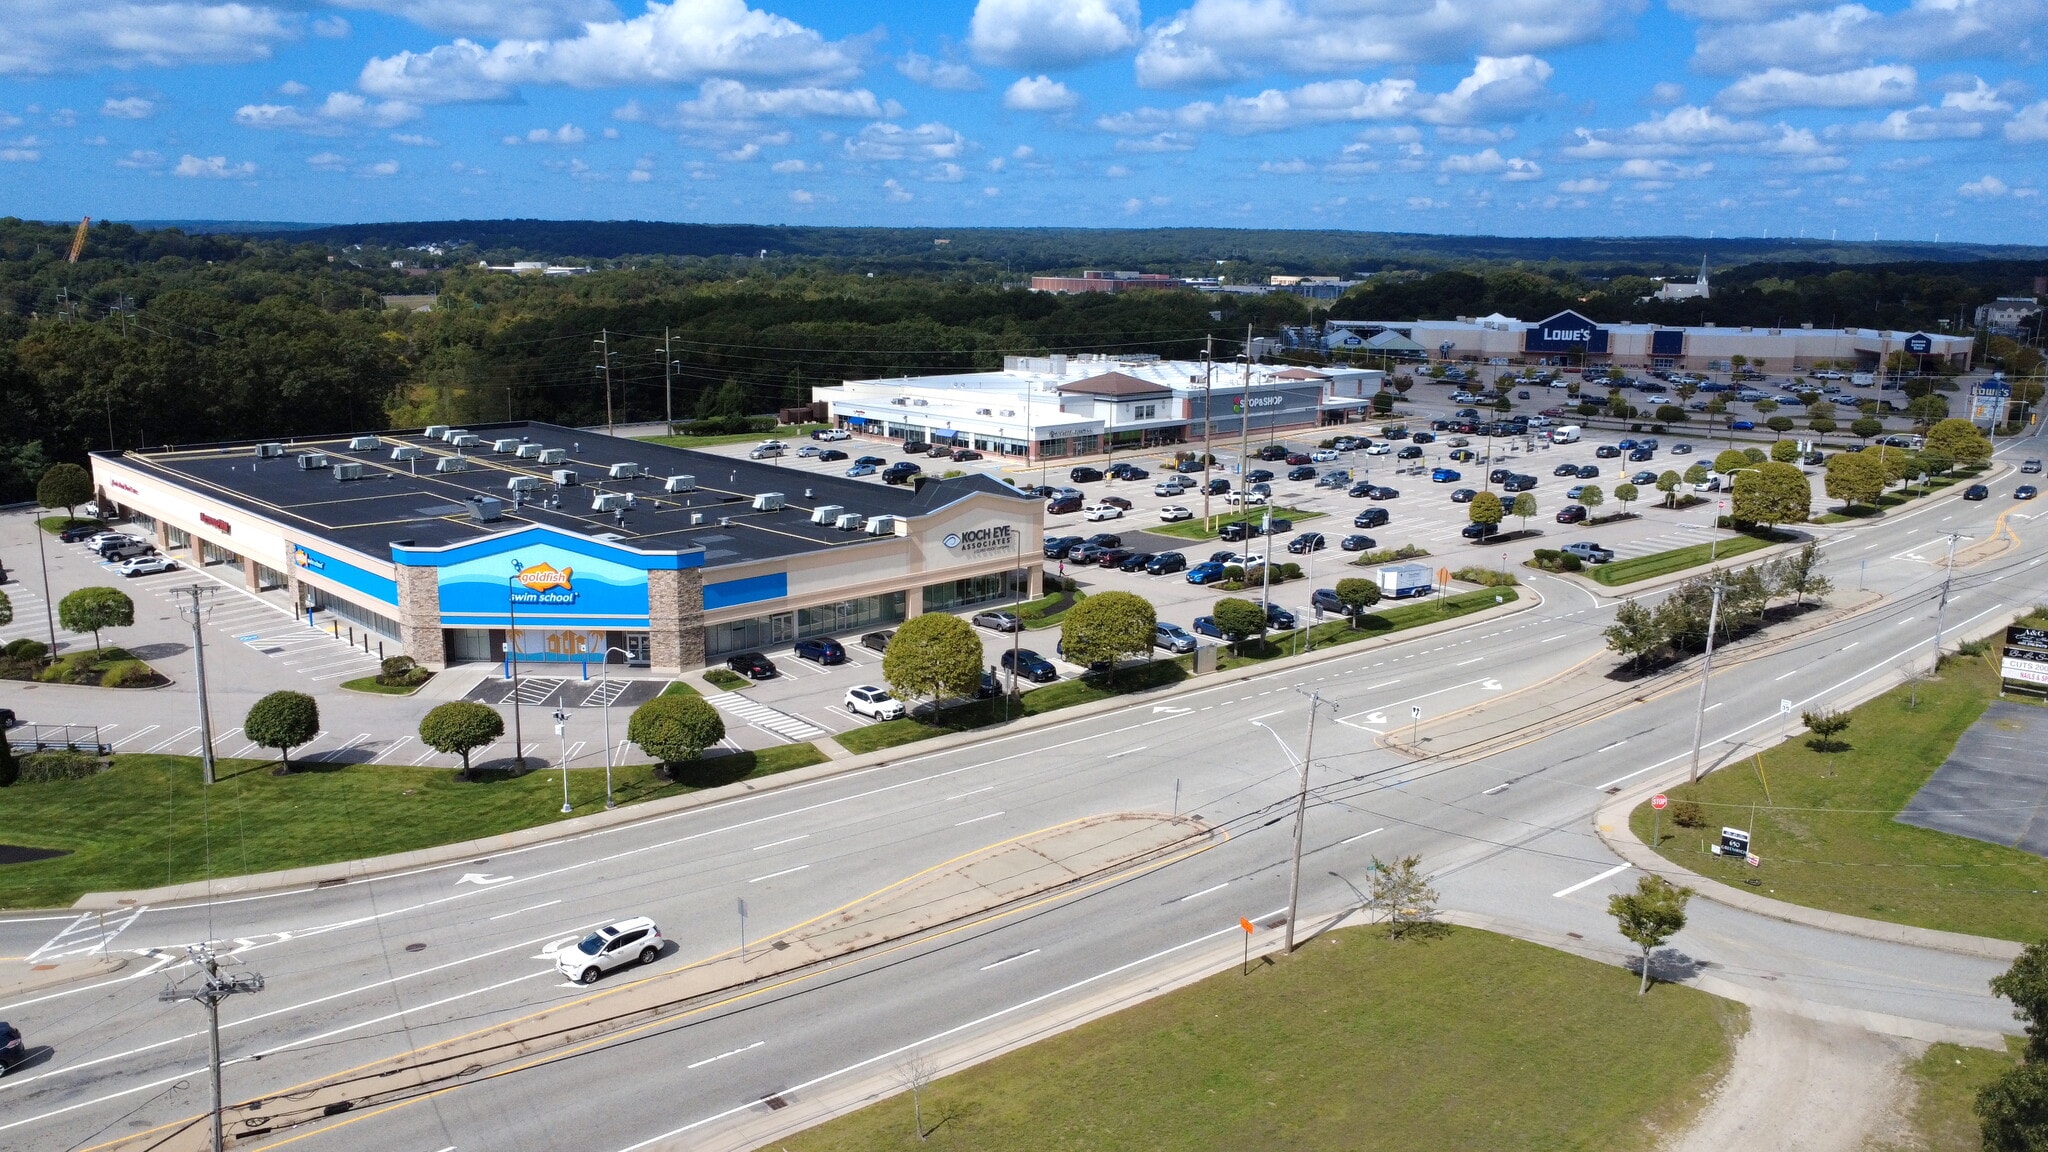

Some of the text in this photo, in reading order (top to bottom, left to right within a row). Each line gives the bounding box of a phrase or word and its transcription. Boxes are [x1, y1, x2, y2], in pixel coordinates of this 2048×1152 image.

[1543, 328, 1591, 341] LOWE'S
[1240, 396, 1283, 408] SOP&SHOP
[962, 525, 1011, 543] KOCH EYE
[961, 537, 1011, 551] ASSOCIATES
[521, 572, 566, 584] goldfish
[510, 592, 574, 602] swim school
[2025, 629, 2044, 637] A&G
[2010, 660, 2033, 669] CUTS
[2020, 672, 2035, 681] NAILS
